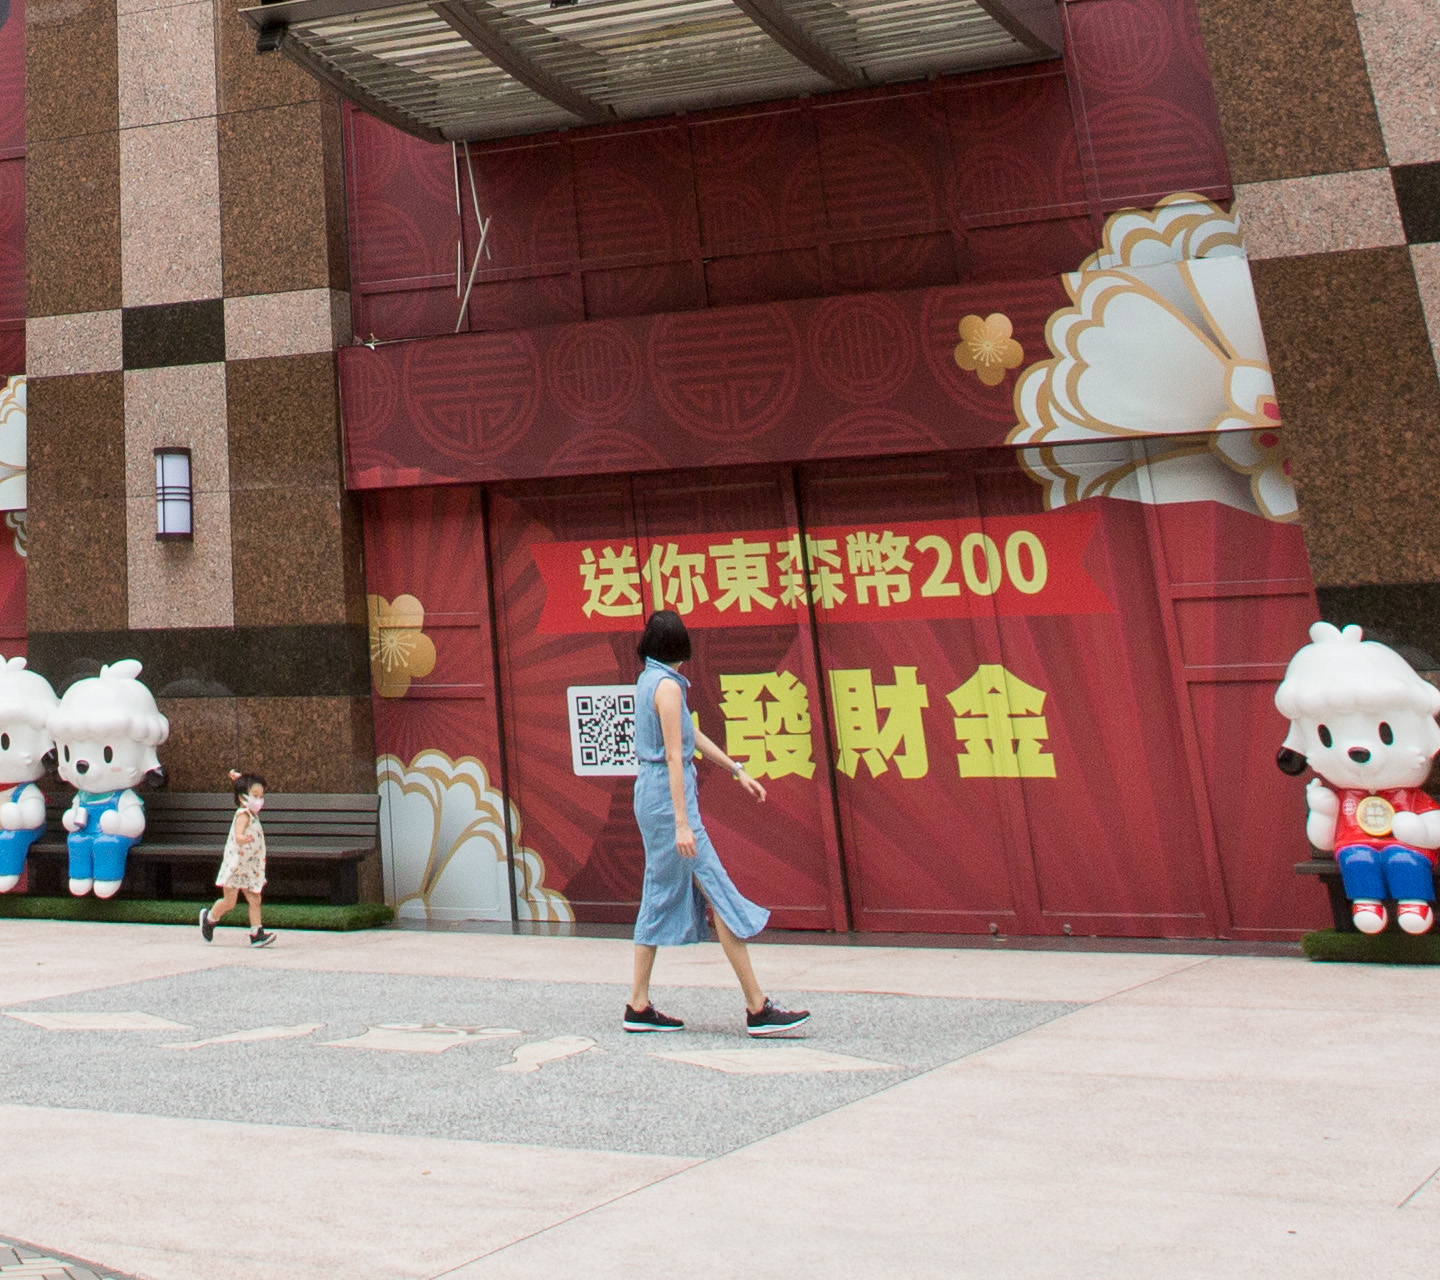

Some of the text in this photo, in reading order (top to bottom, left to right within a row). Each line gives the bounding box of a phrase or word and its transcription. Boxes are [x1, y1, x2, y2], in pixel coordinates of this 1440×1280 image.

[579, 529, 1049, 619] 送你東森幣200
[718, 664, 1058, 780] 發財金
